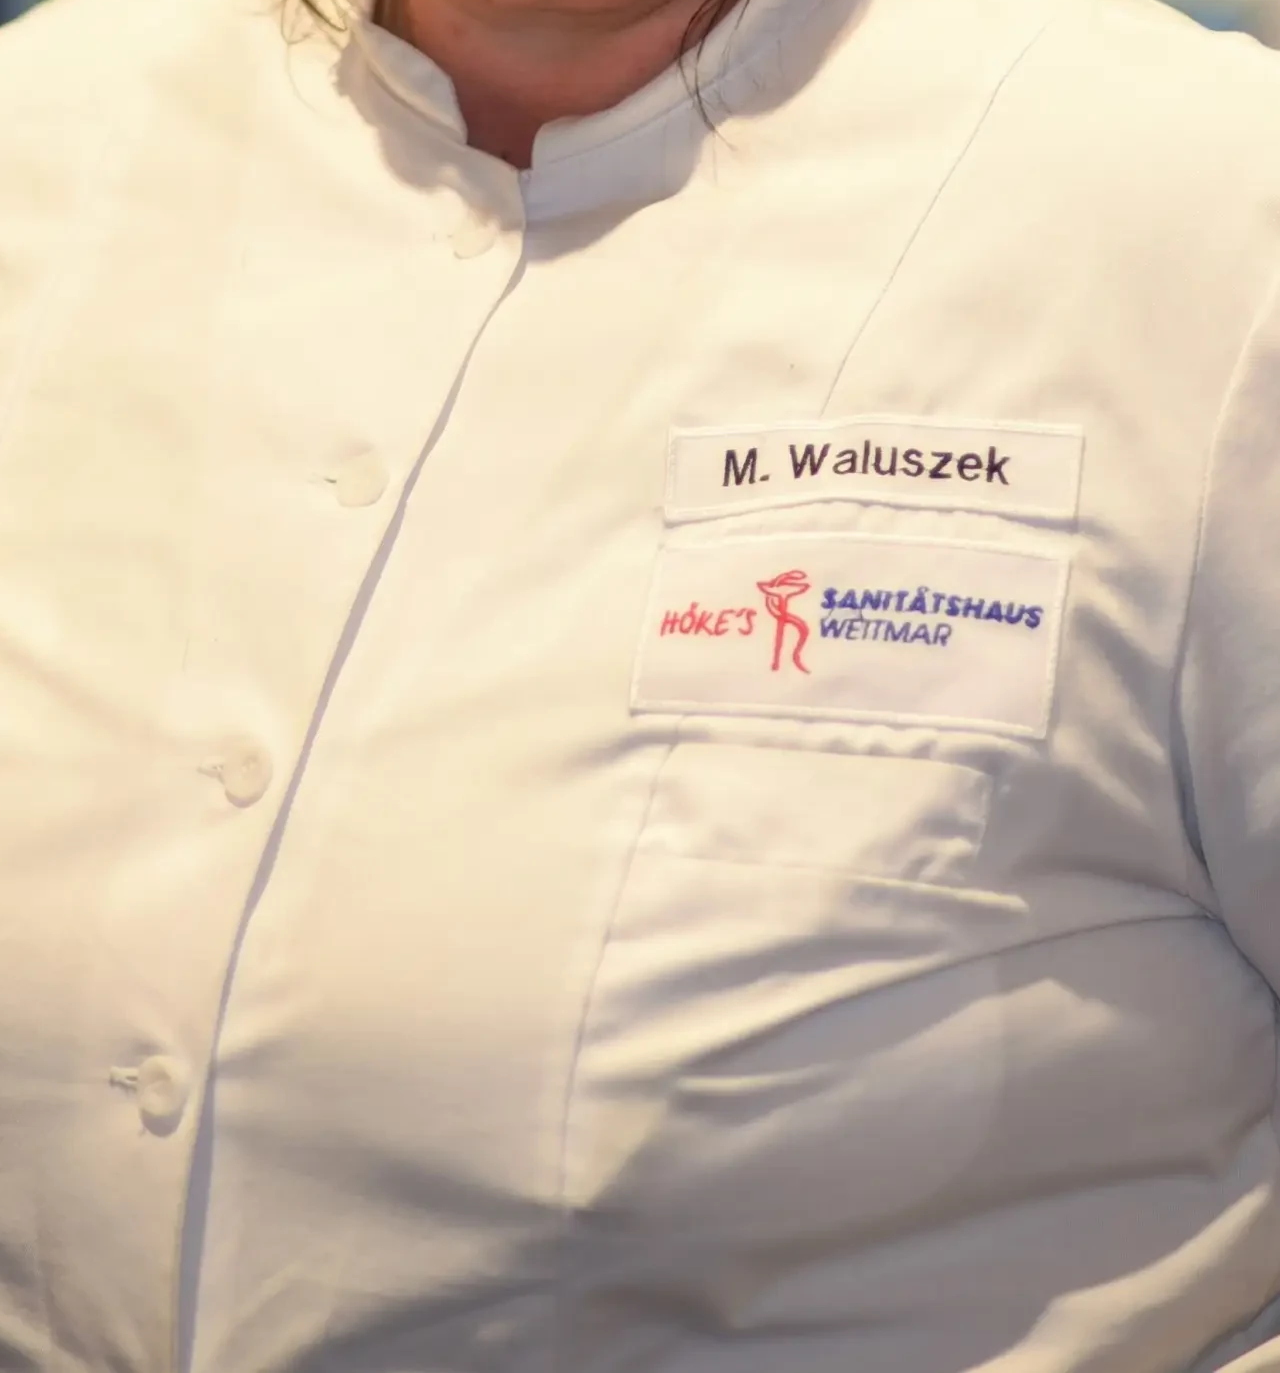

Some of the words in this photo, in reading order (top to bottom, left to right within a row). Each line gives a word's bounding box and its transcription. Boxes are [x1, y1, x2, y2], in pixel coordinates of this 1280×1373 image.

[722, 447, 770, 487] M.
[789, 439, 1011, 486] Waluszek
[820, 586, 1044, 629] SANITÄTSHAUS
[819, 616, 953, 647] WEITMAR
